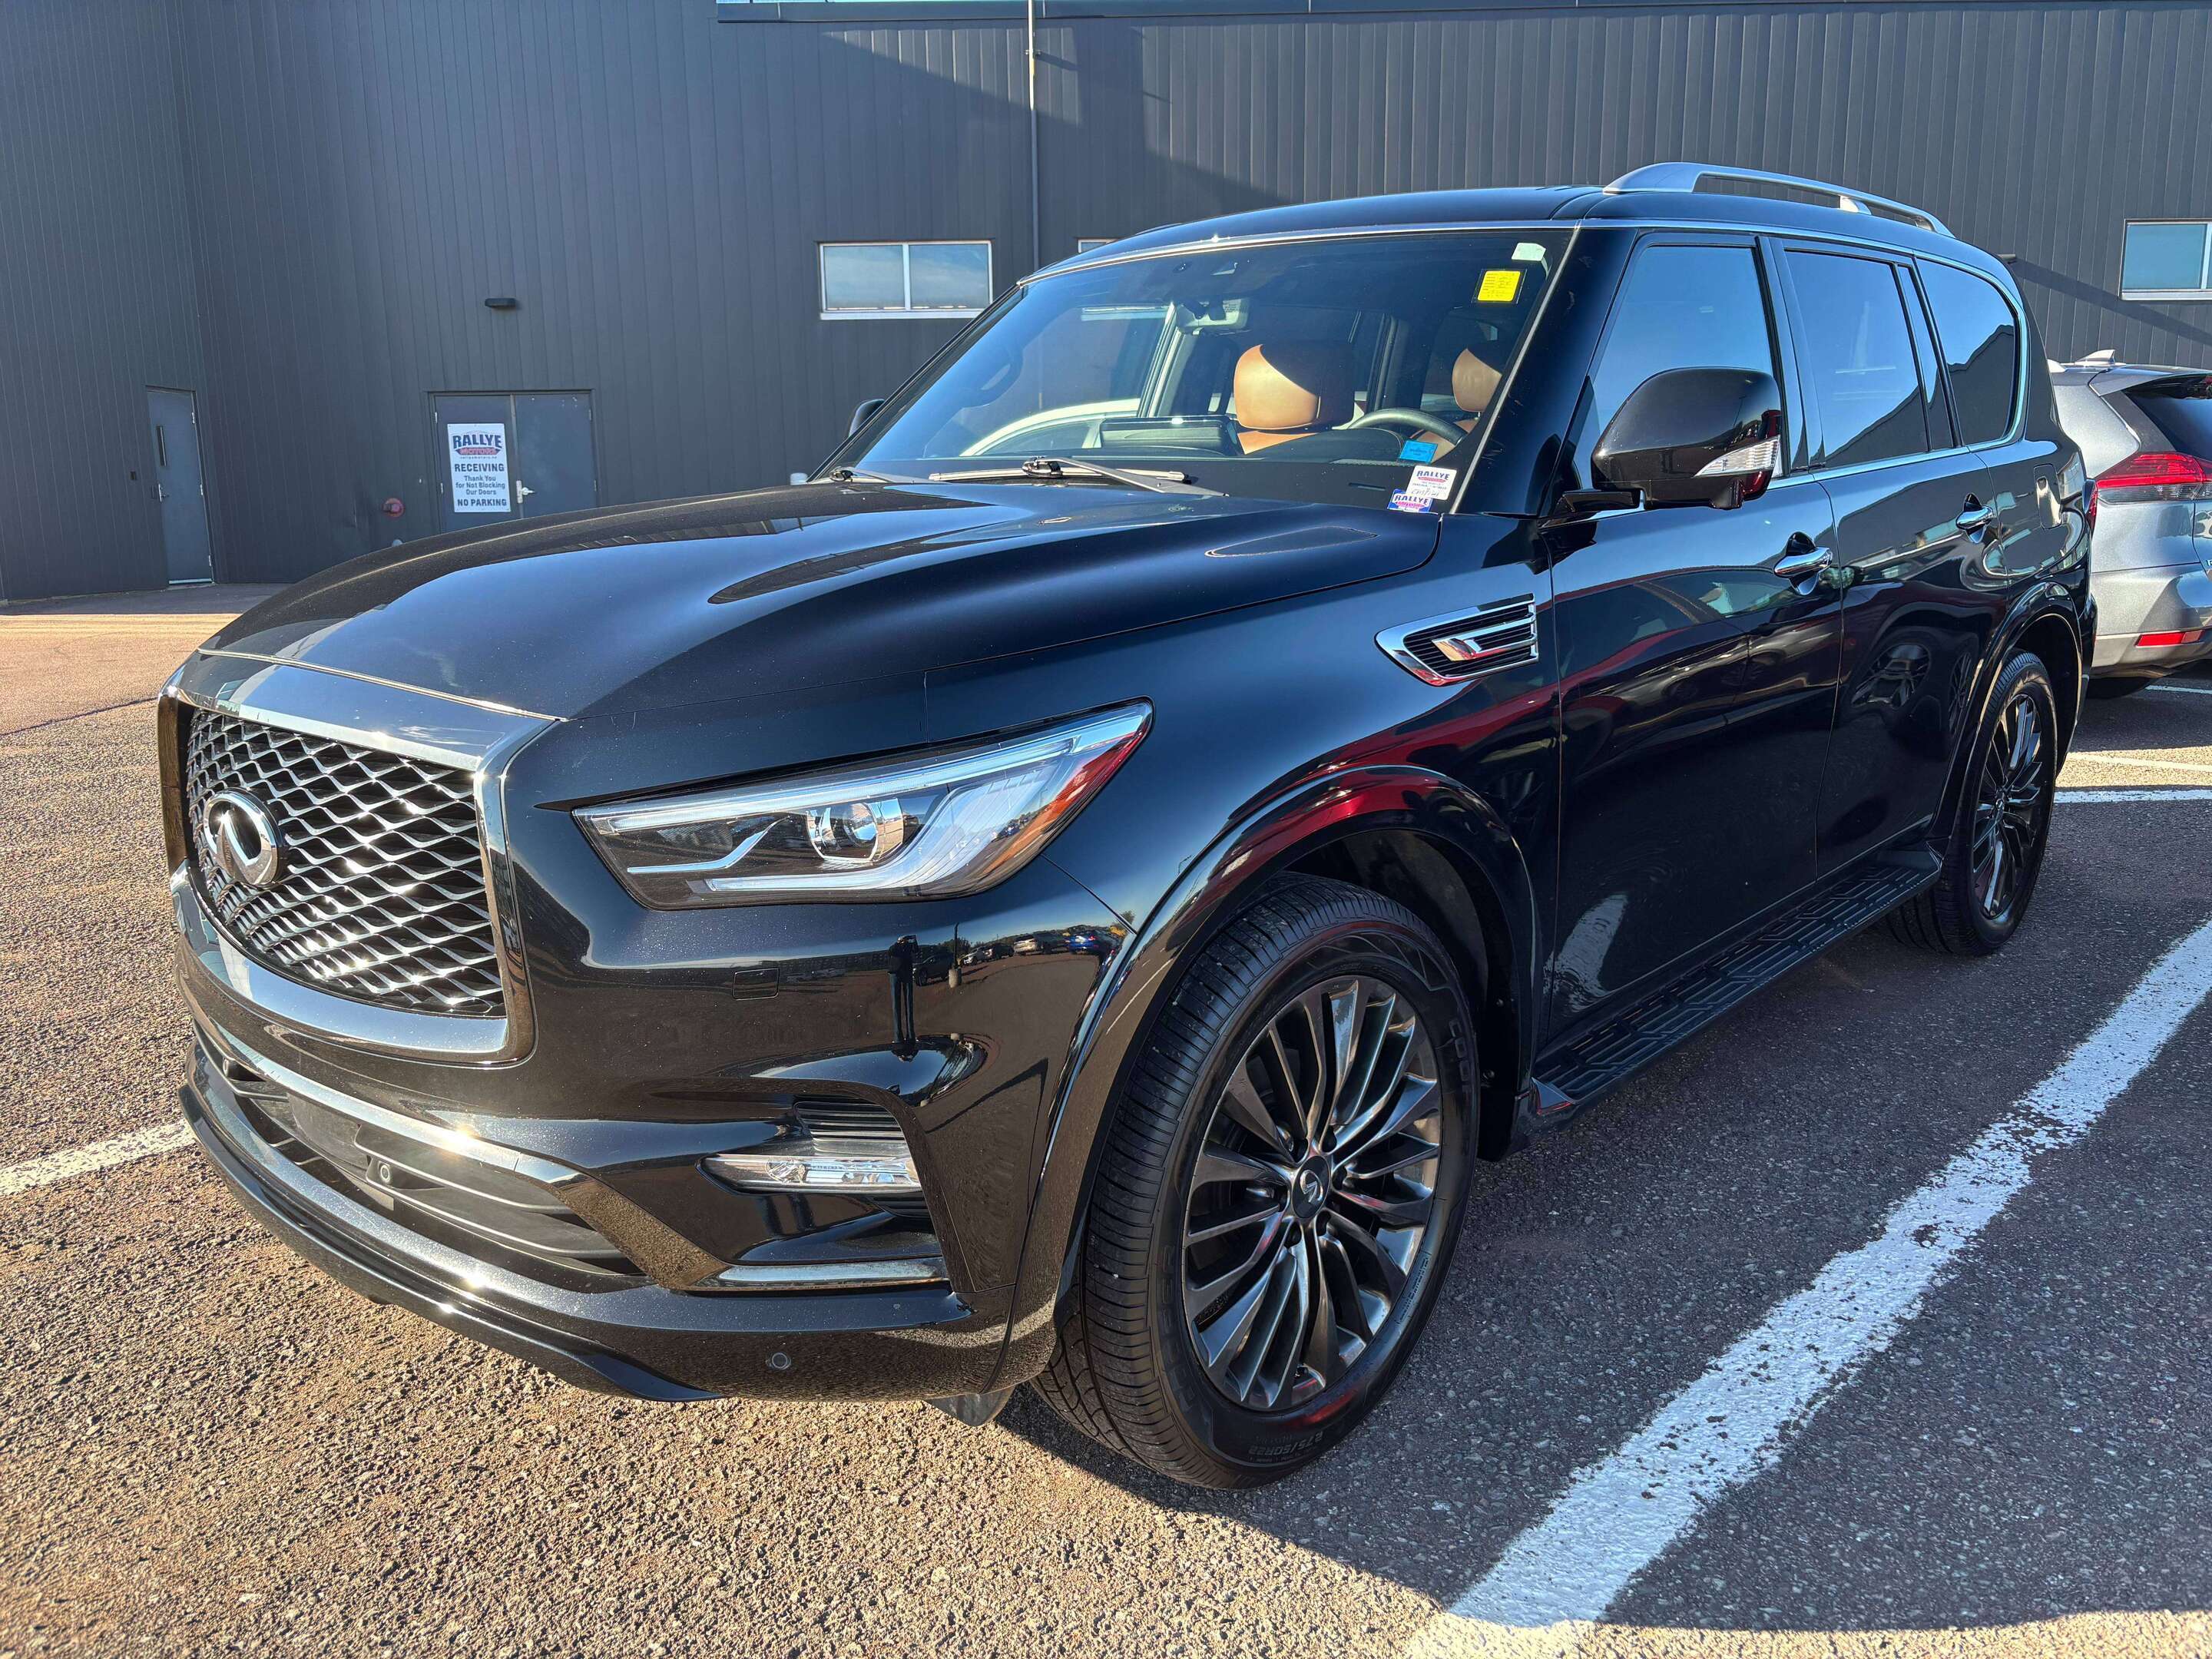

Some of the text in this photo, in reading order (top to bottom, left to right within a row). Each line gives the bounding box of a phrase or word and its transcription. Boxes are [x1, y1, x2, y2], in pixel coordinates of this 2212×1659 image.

[453, 434, 502, 449] RALLYE
[455, 463, 505, 472] RECEIVING
[1416, 470, 1450, 481] RALLYE
[1394, 495, 1429, 505] RALLYE
